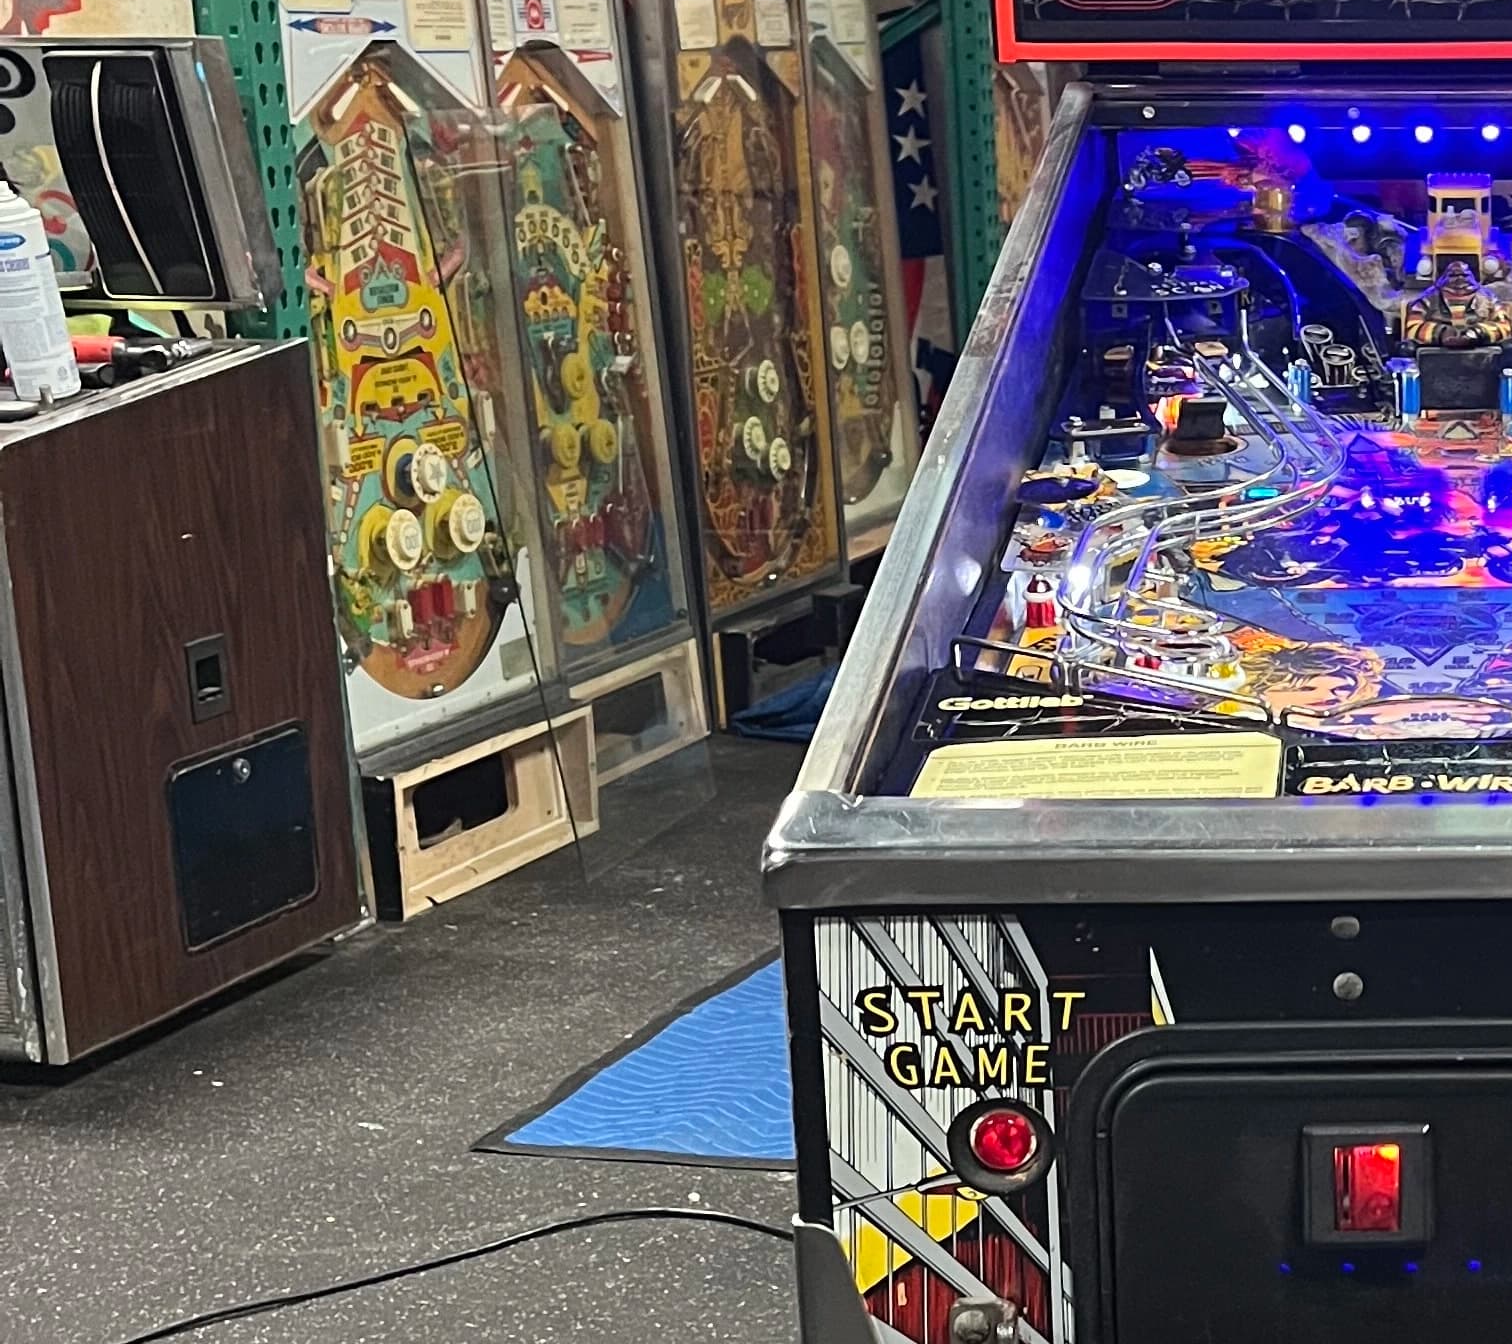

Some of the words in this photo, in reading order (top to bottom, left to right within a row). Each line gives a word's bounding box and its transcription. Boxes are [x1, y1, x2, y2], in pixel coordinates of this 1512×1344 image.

[1302, 773, 1416, 795] BARB
[863, 991, 1086, 1033] START
[890, 1045, 1050, 1087] GAME
